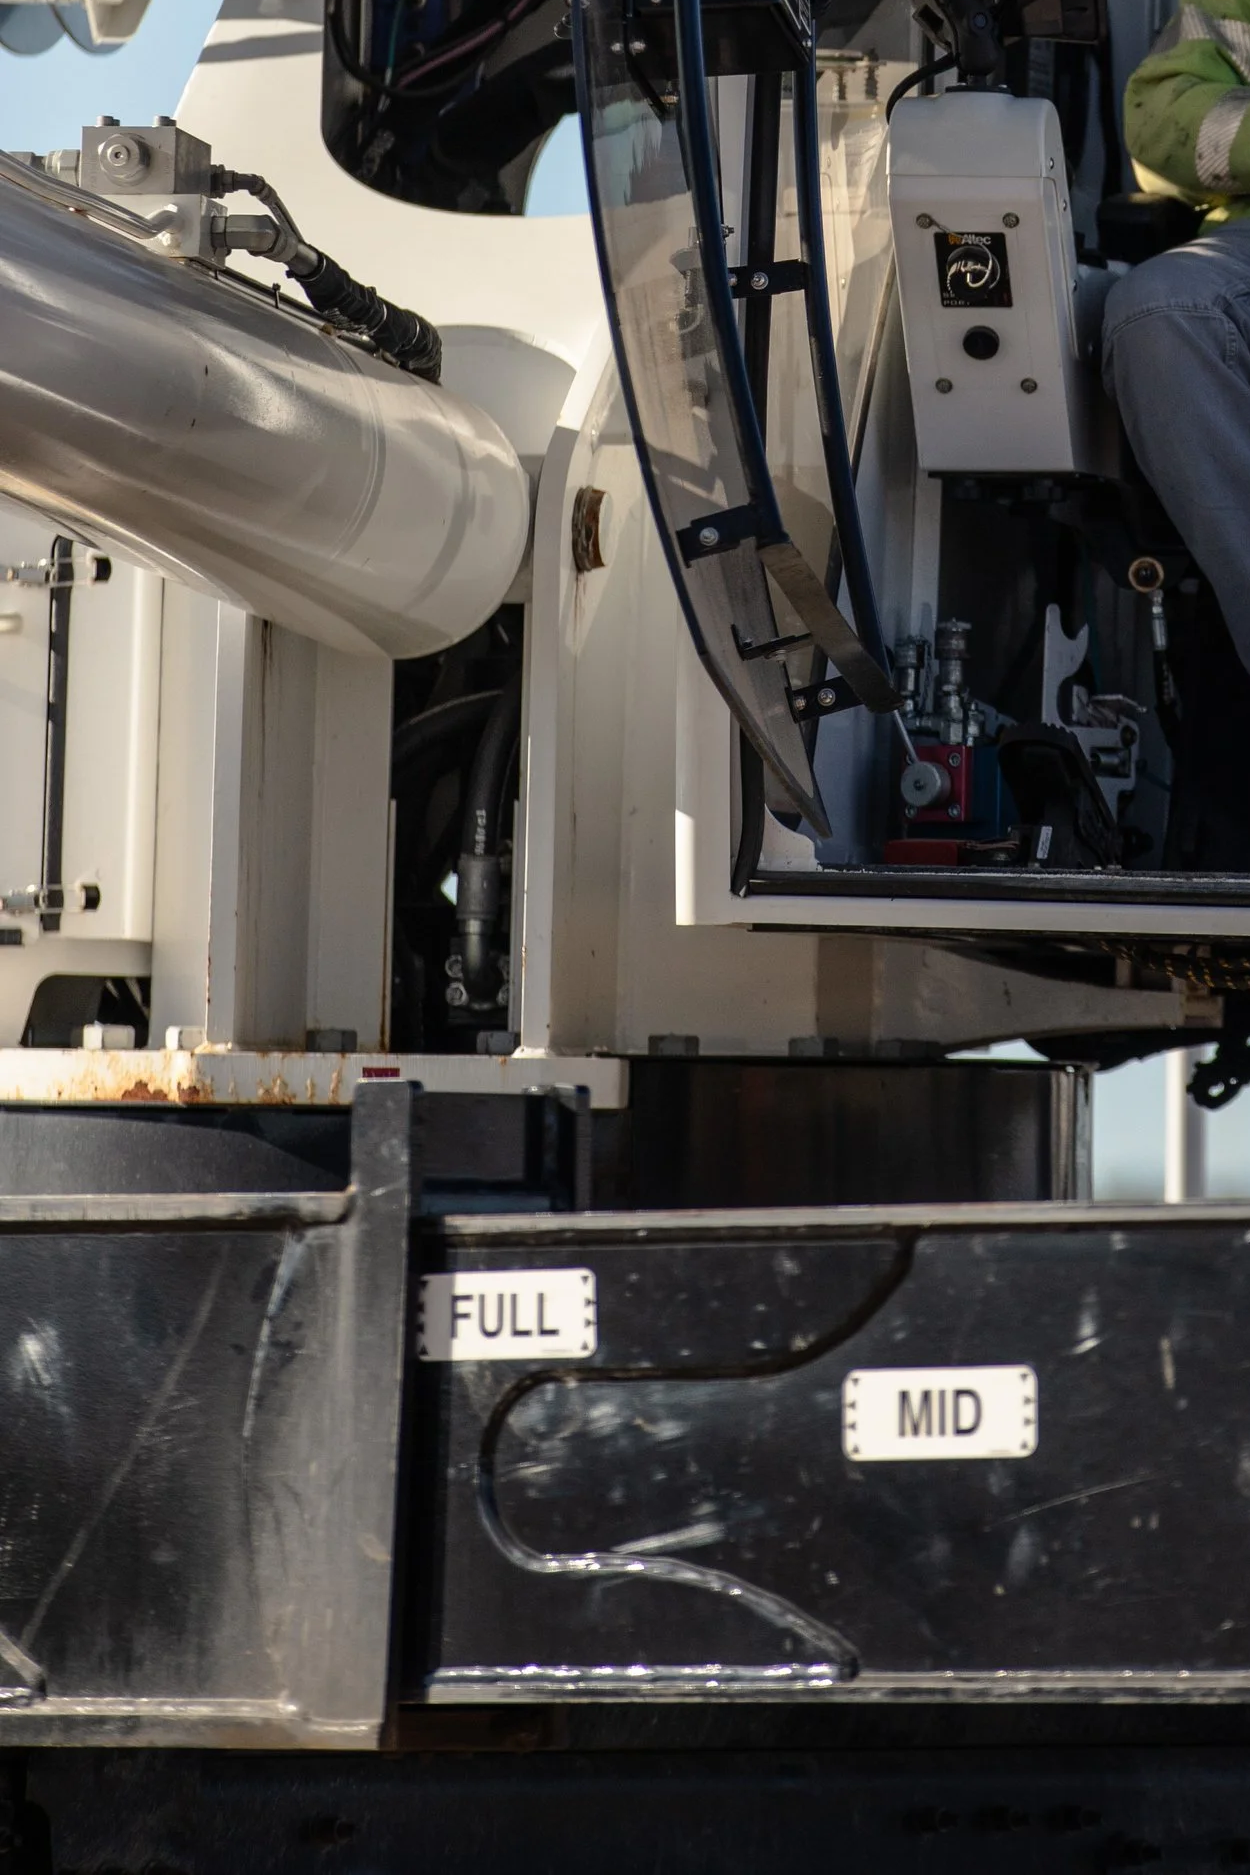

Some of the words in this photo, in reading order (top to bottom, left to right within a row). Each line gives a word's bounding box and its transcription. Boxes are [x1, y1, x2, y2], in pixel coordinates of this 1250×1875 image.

[961, 233, 992, 245] Altec
[450, 1292, 560, 1339] FULL
[898, 1389, 983, 1437] MID
